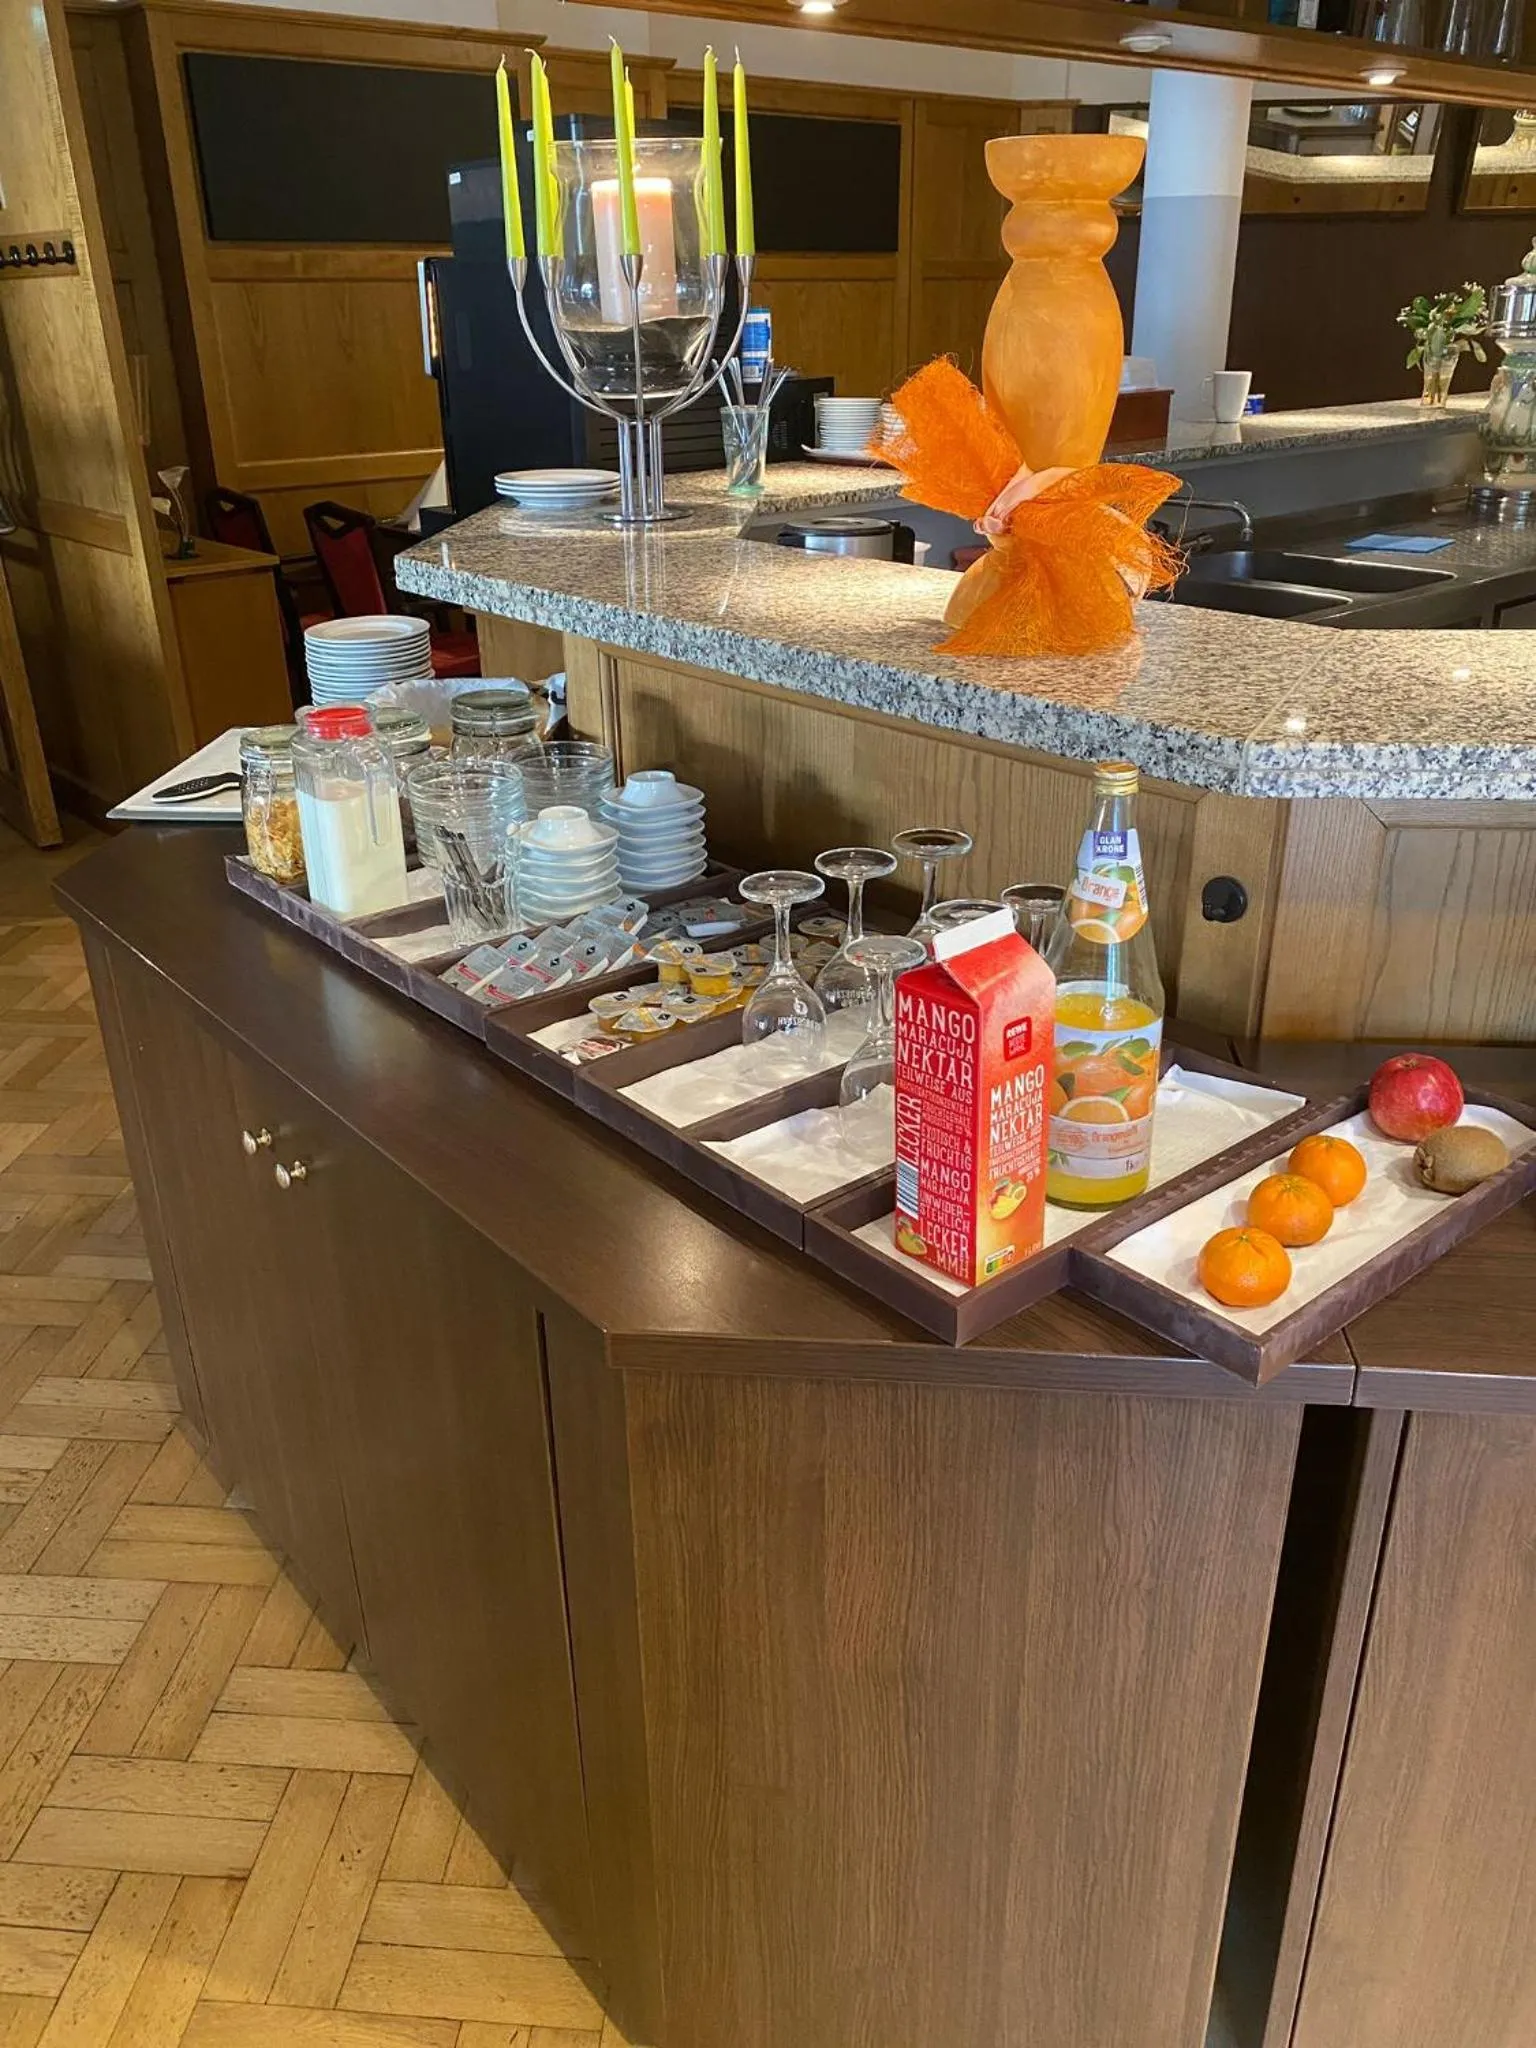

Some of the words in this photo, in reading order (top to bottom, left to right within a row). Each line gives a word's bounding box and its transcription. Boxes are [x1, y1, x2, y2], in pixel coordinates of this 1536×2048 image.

[898, 990, 975, 1043] MANGO
[898, 1020, 973, 1063] MARACUJA
[897, 1037, 973, 1090] NEKTAR
[897, 1062, 946, 1095] TEILWEISE
[951, 1085, 973, 1104] AUS
[990, 1089, 1042, 1125] MARACUJA
[991, 1063, 1044, 1112] MANGO
[896, 1093, 921, 1166] LECKER
[921, 1123, 961, 1150] EXOTISCH
[963, 1139, 972, 1156] &
[990, 1103, 1042, 1146] NEKTAR
[920, 1158, 970, 1192] MANGO
[921, 1138, 972, 1171] FRUCHTIG
[920, 1178, 970, 1205] MARACUJA
[920, 1191, 970, 1219] UNWIDER-
[920, 1202, 970, 1233] STEHLICH
[920, 1217, 969, 1259] LECKER
